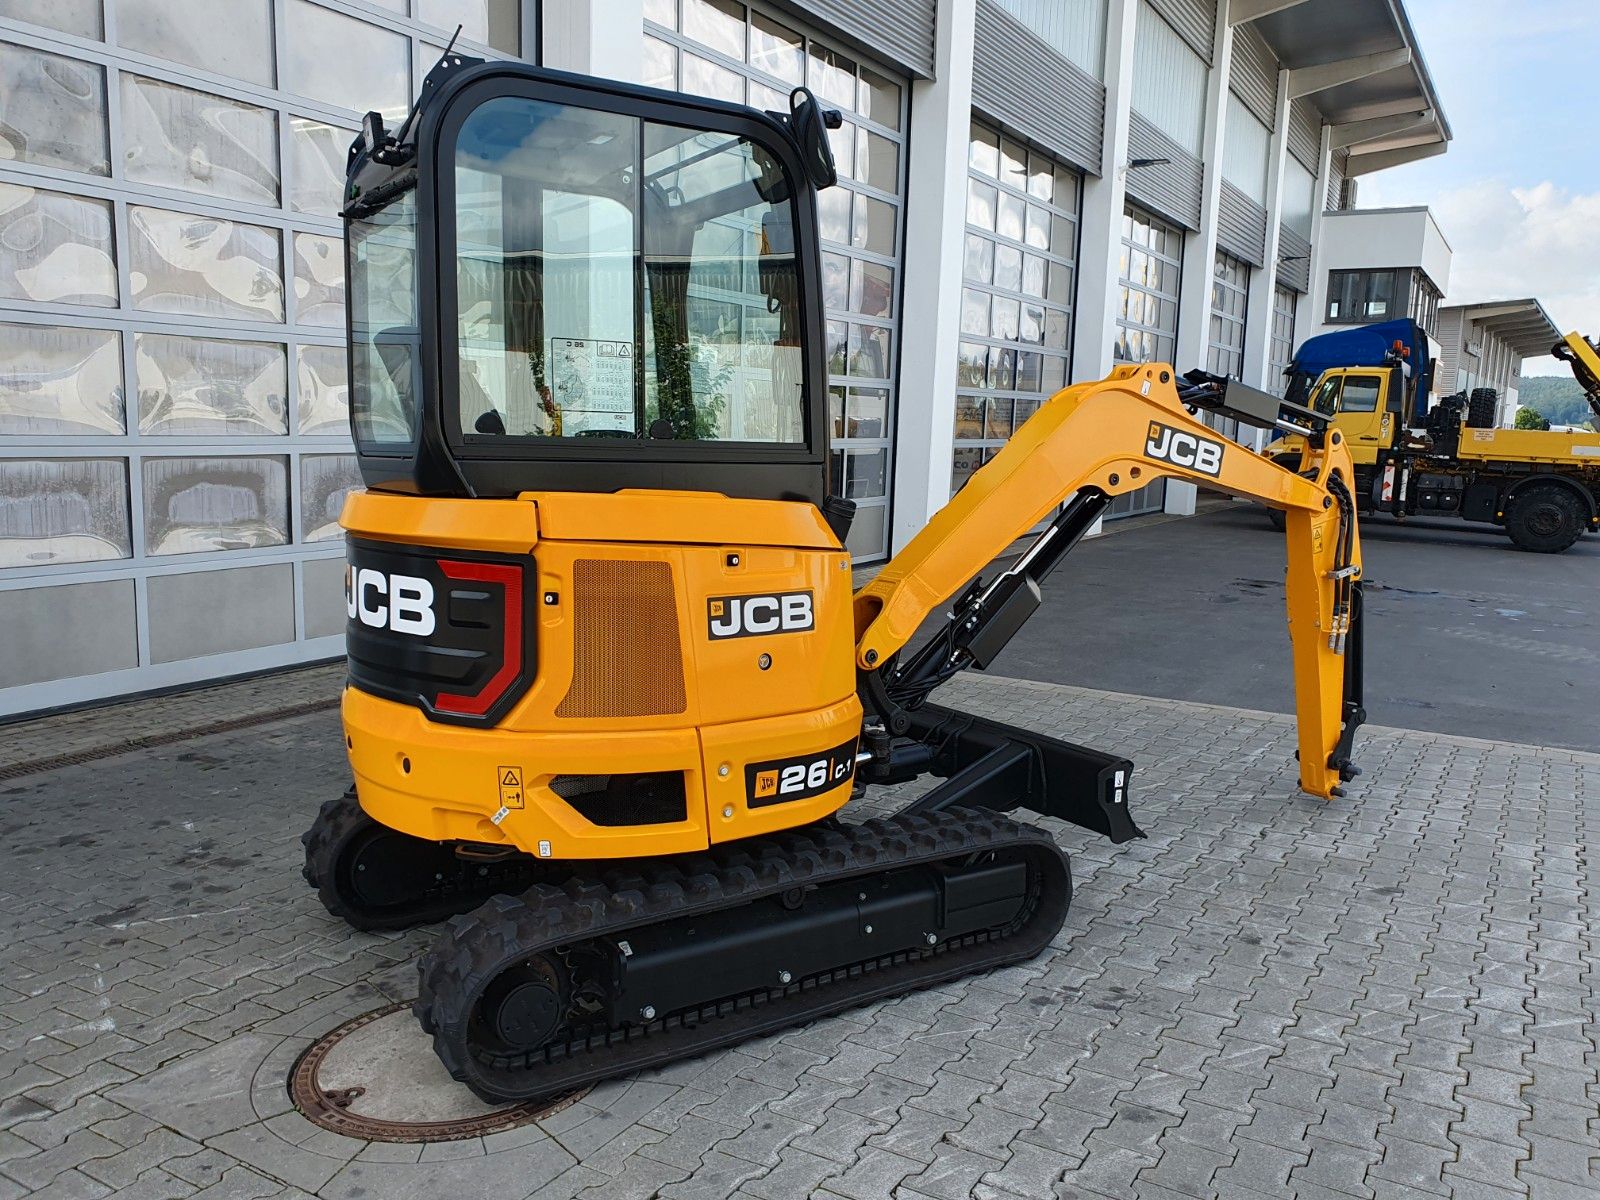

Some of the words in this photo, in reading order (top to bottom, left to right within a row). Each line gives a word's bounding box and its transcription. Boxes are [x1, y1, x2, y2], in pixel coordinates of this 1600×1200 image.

[1147, 428, 1222, 474] JCB
[347, 564, 436, 637] JCB
[711, 594, 813, 636] JCB
[780, 759, 828, 794] 26
